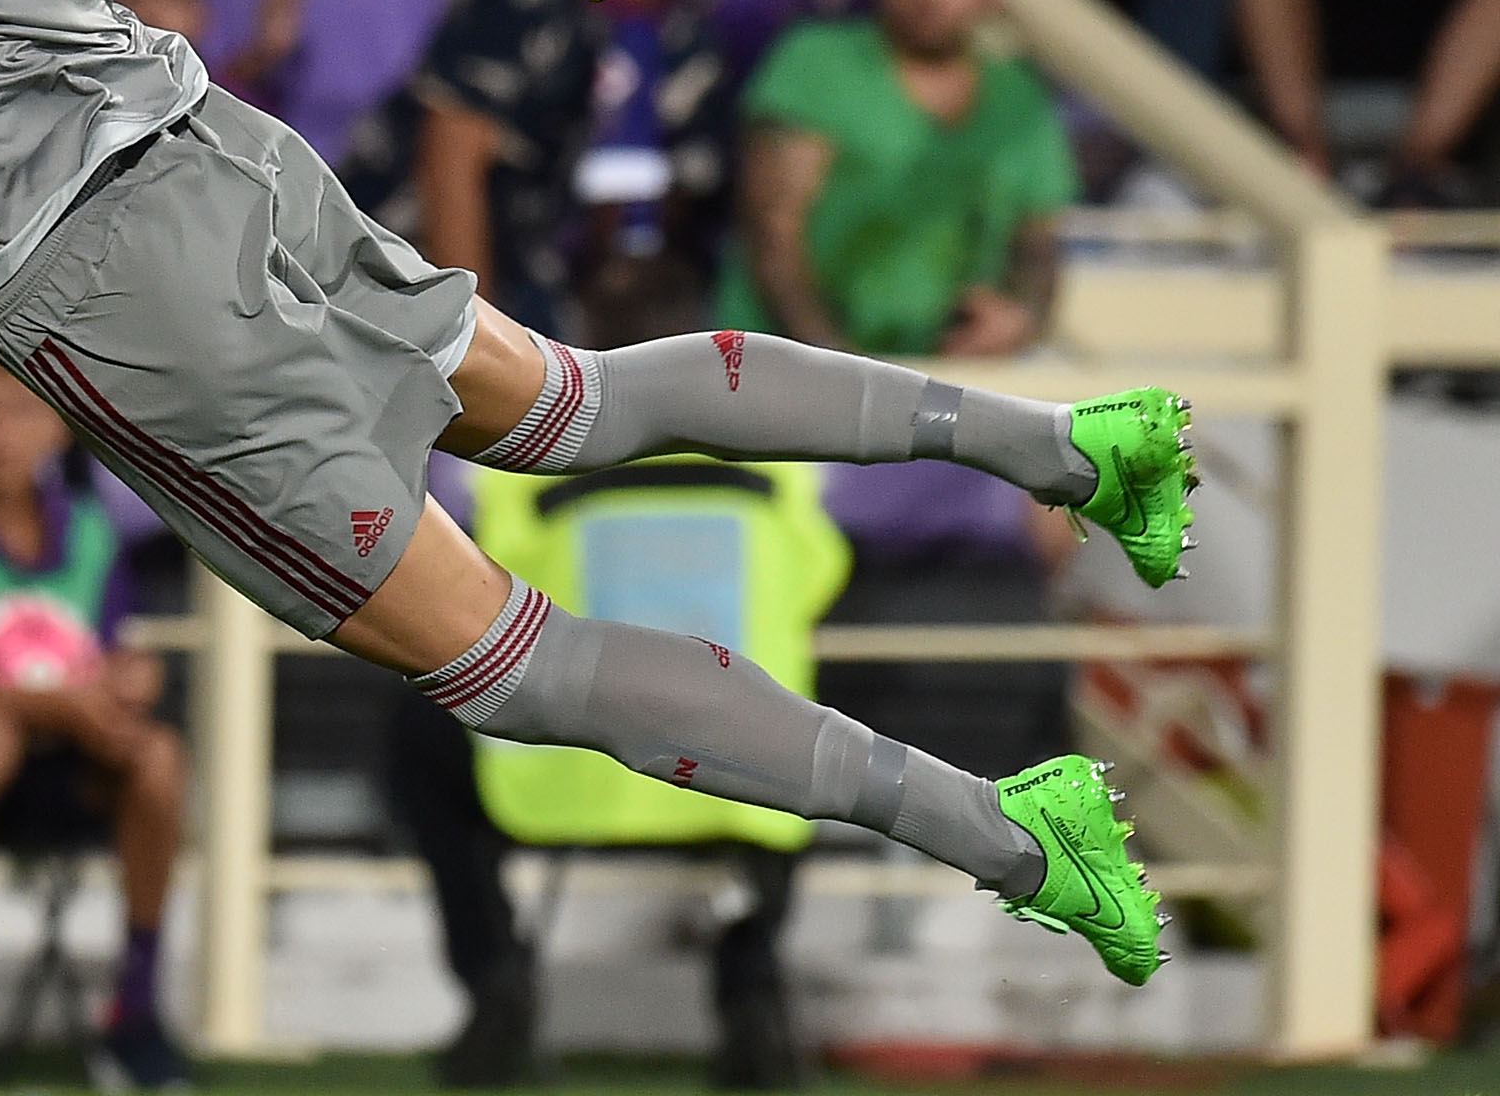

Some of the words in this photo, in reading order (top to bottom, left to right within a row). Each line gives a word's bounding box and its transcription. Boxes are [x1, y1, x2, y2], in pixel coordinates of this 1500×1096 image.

[1076, 400, 1142, 416] TIEMPO
[358, 507, 394, 557] adidas
[1003, 768, 1063, 796] TIEMPO
